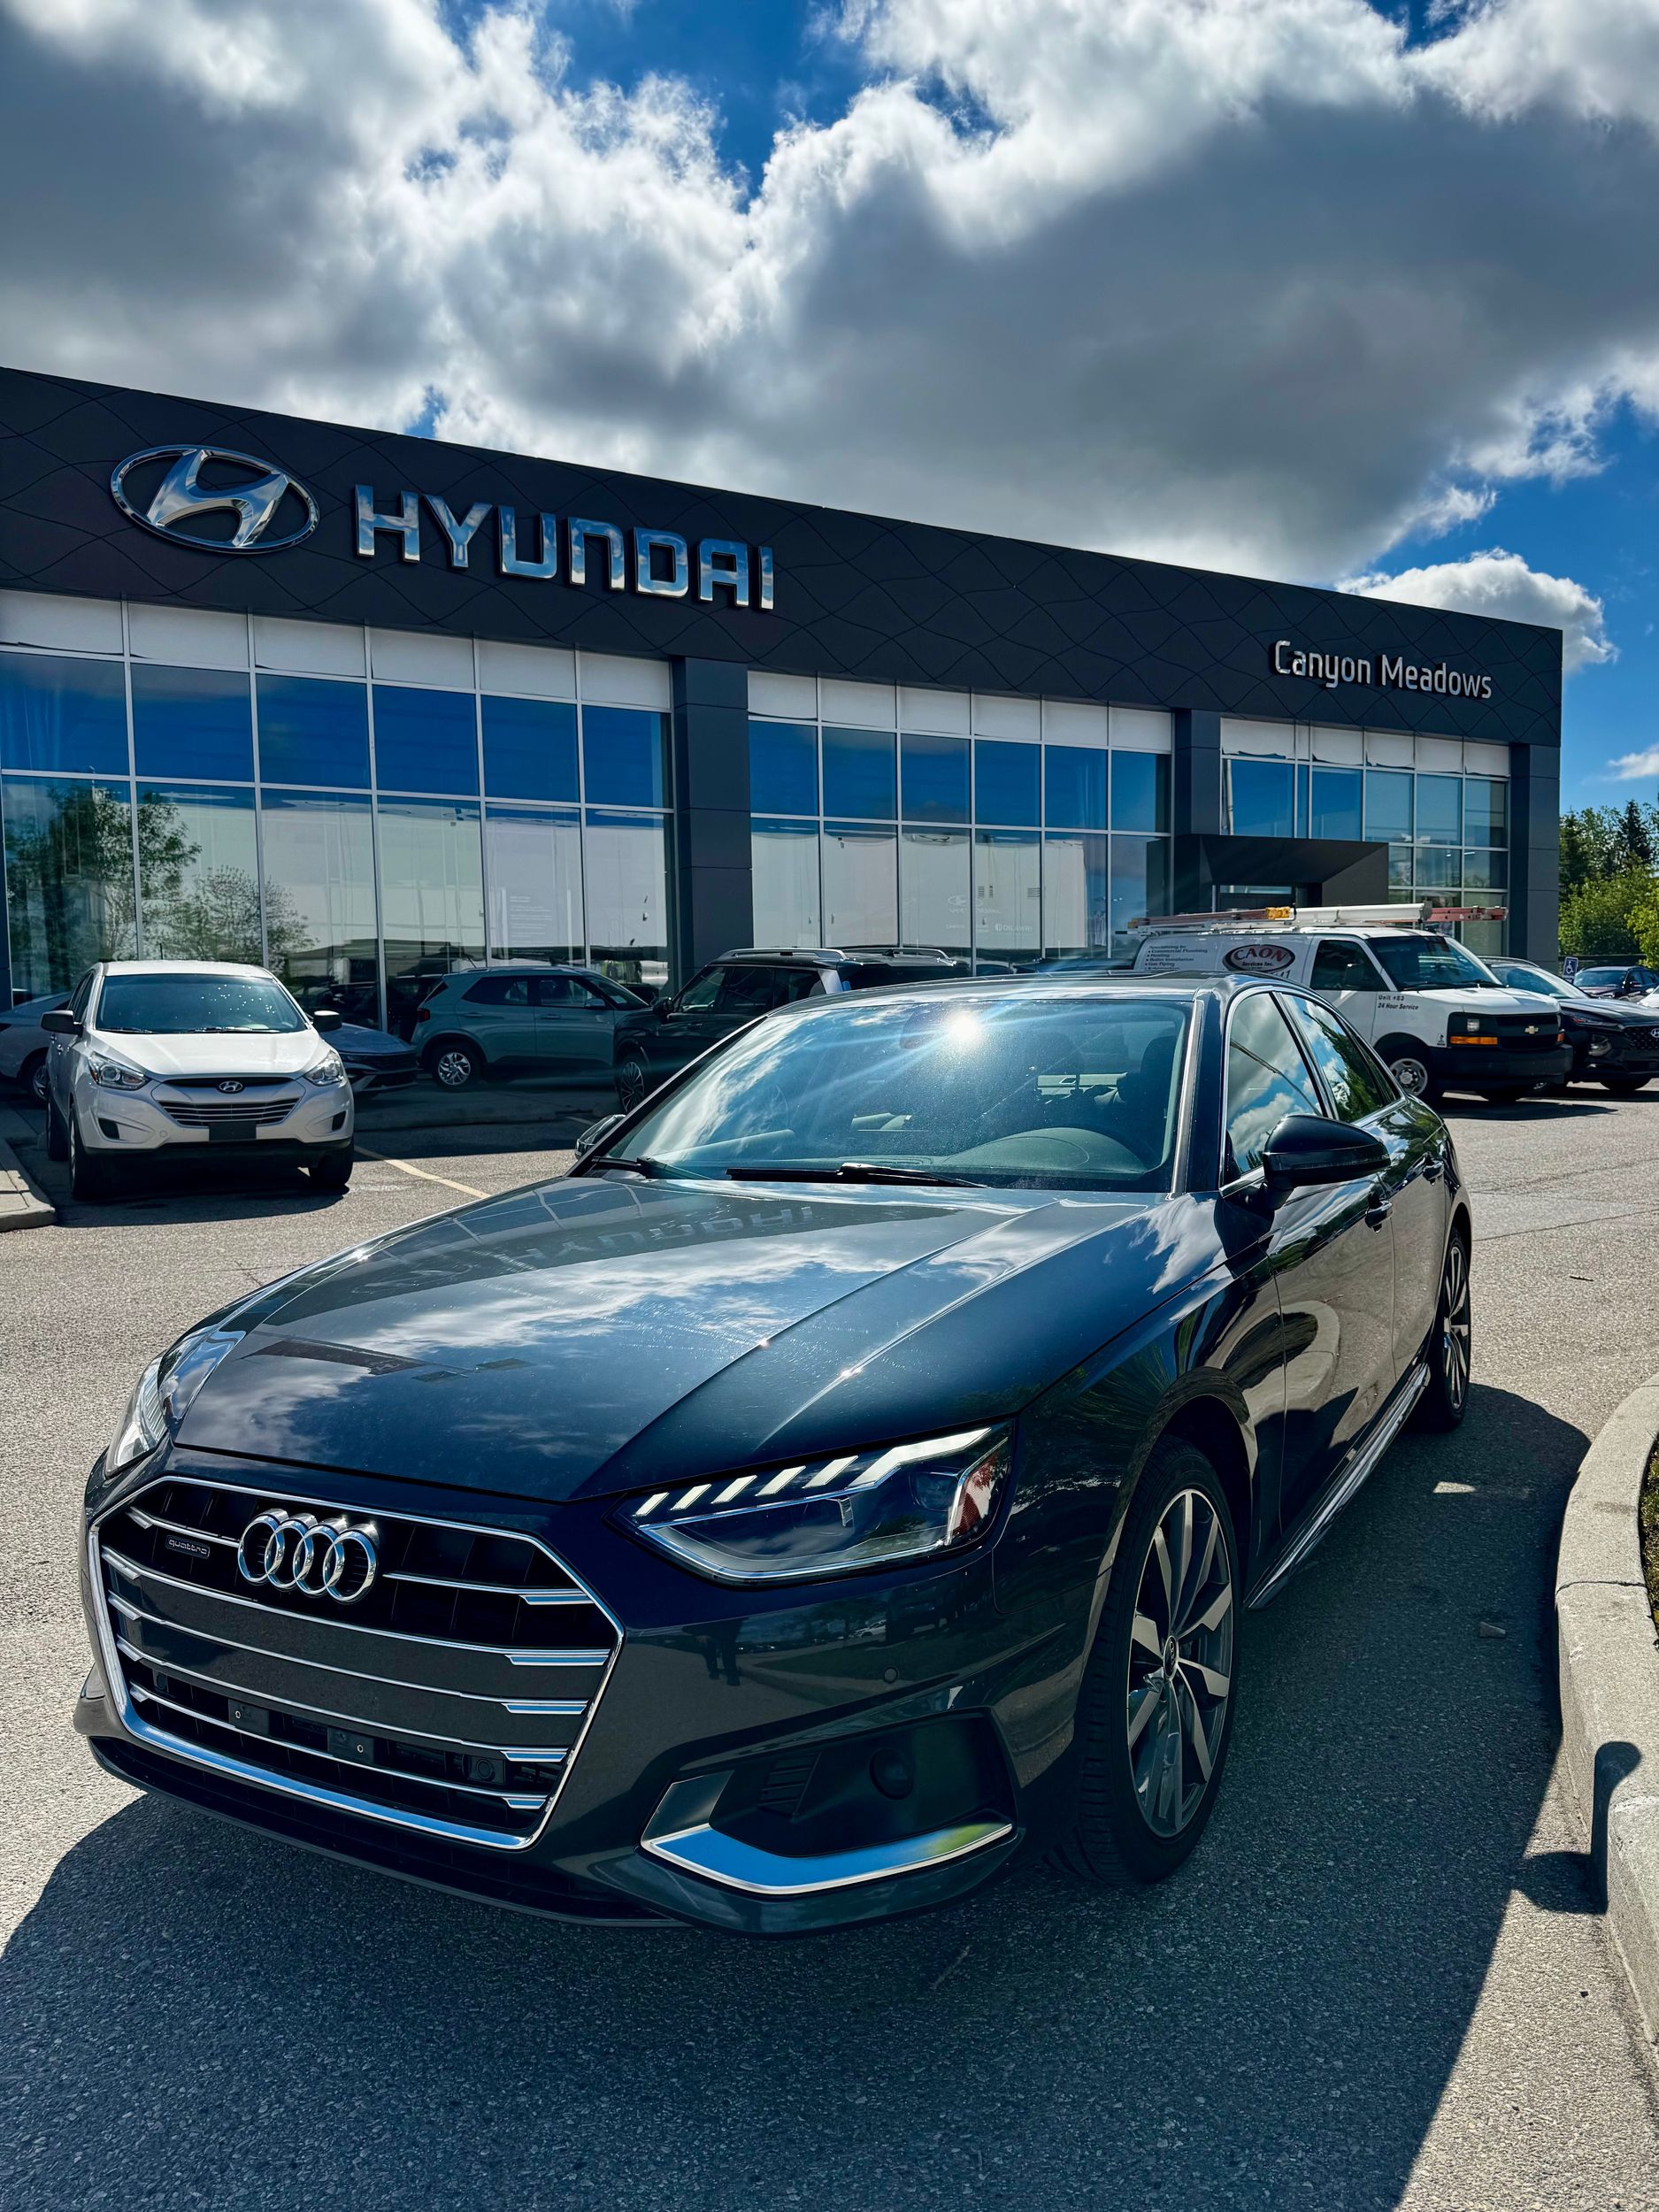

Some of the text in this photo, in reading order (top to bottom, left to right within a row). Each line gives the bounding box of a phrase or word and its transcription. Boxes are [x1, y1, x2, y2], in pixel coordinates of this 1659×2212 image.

[355, 483, 775, 611] HYUNDAI
[1274, 640, 1493, 699] Canyon Meadows
[1233, 948, 1289, 963] CAON
[168, 1539, 208, 1555] quattro
